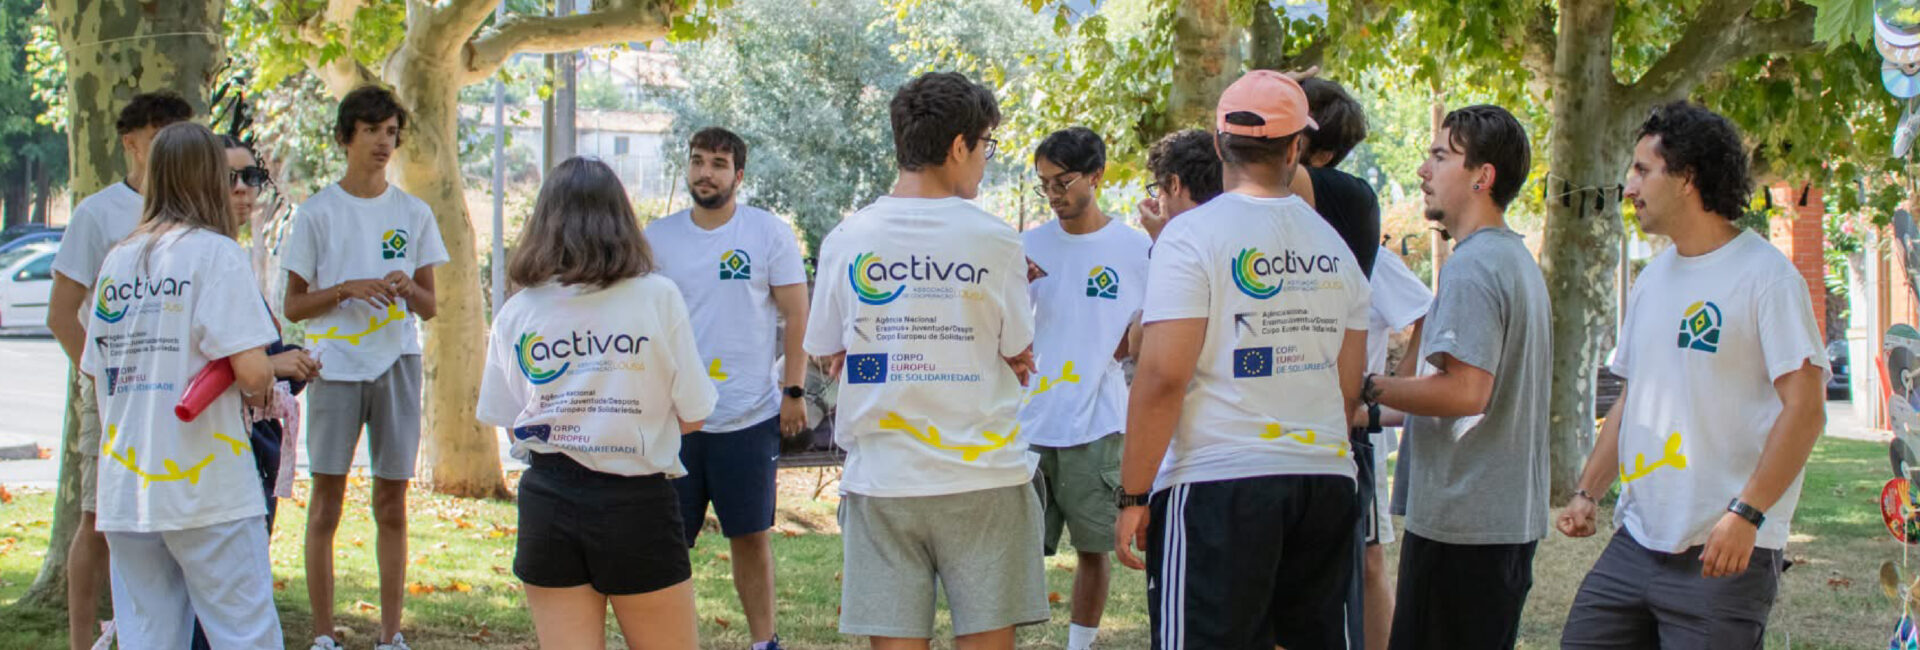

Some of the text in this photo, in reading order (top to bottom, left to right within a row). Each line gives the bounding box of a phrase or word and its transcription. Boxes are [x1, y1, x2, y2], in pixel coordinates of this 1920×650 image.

[1253, 249, 1340, 276] activar
[867, 254, 989, 284] activar
[104, 276, 191, 302] activar
[904, 315, 937, 323] Nacional
[897, 333, 927, 342] Europeu
[928, 333, 938, 341] de
[531, 330, 649, 361] activar
[891, 353, 924, 362] CORPO
[890, 363, 936, 372] EUROPEU
[890, 373, 903, 382] DE
